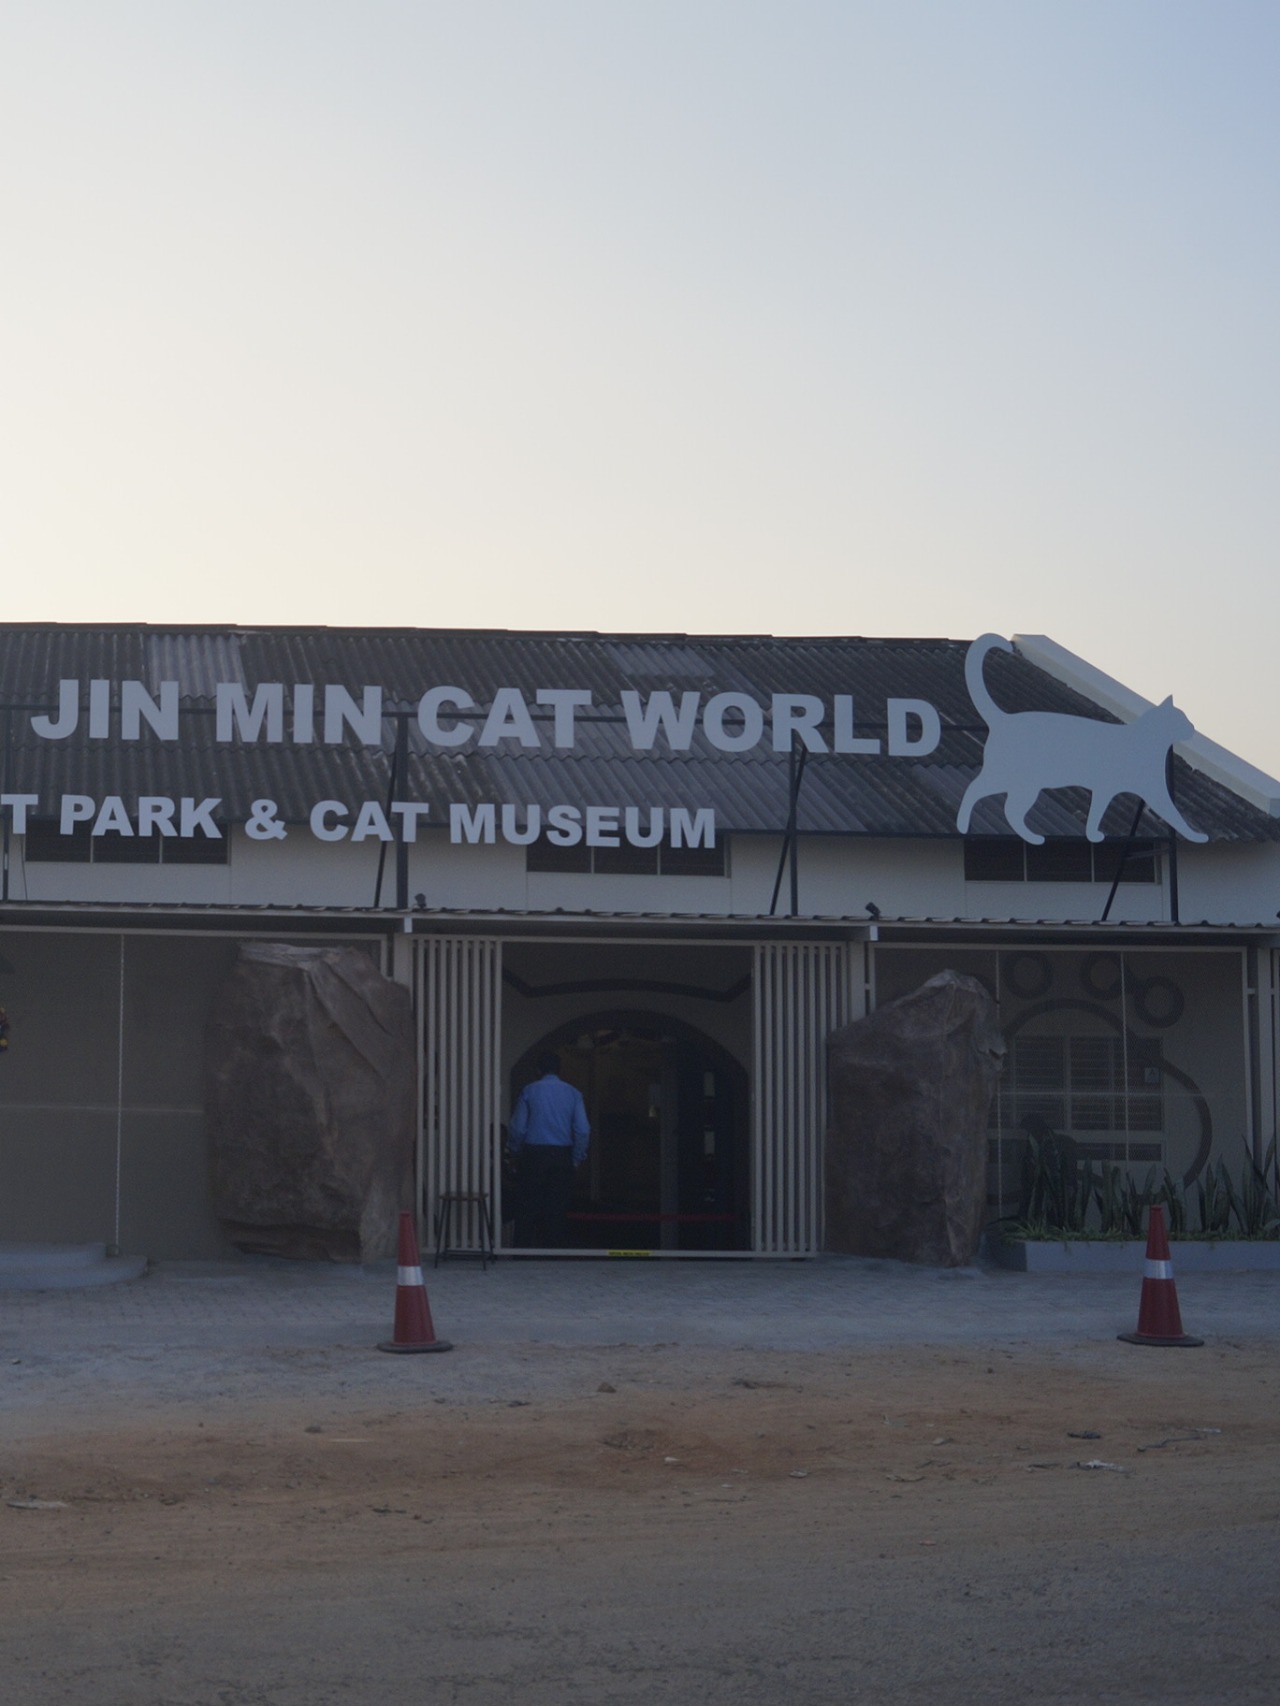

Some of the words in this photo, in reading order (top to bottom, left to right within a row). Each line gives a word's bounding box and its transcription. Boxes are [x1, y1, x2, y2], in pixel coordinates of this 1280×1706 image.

[30, 679, 180, 740] JIN
[216, 682, 382, 745] MIN
[418, 686, 592, 748] CAT
[620, 690, 942, 757] WORLD
[59, 794, 222, 839] PARK
[244, 799, 288, 841] &
[309, 800, 429, 843] CAT
[449, 803, 716, 849] MUSEUM
